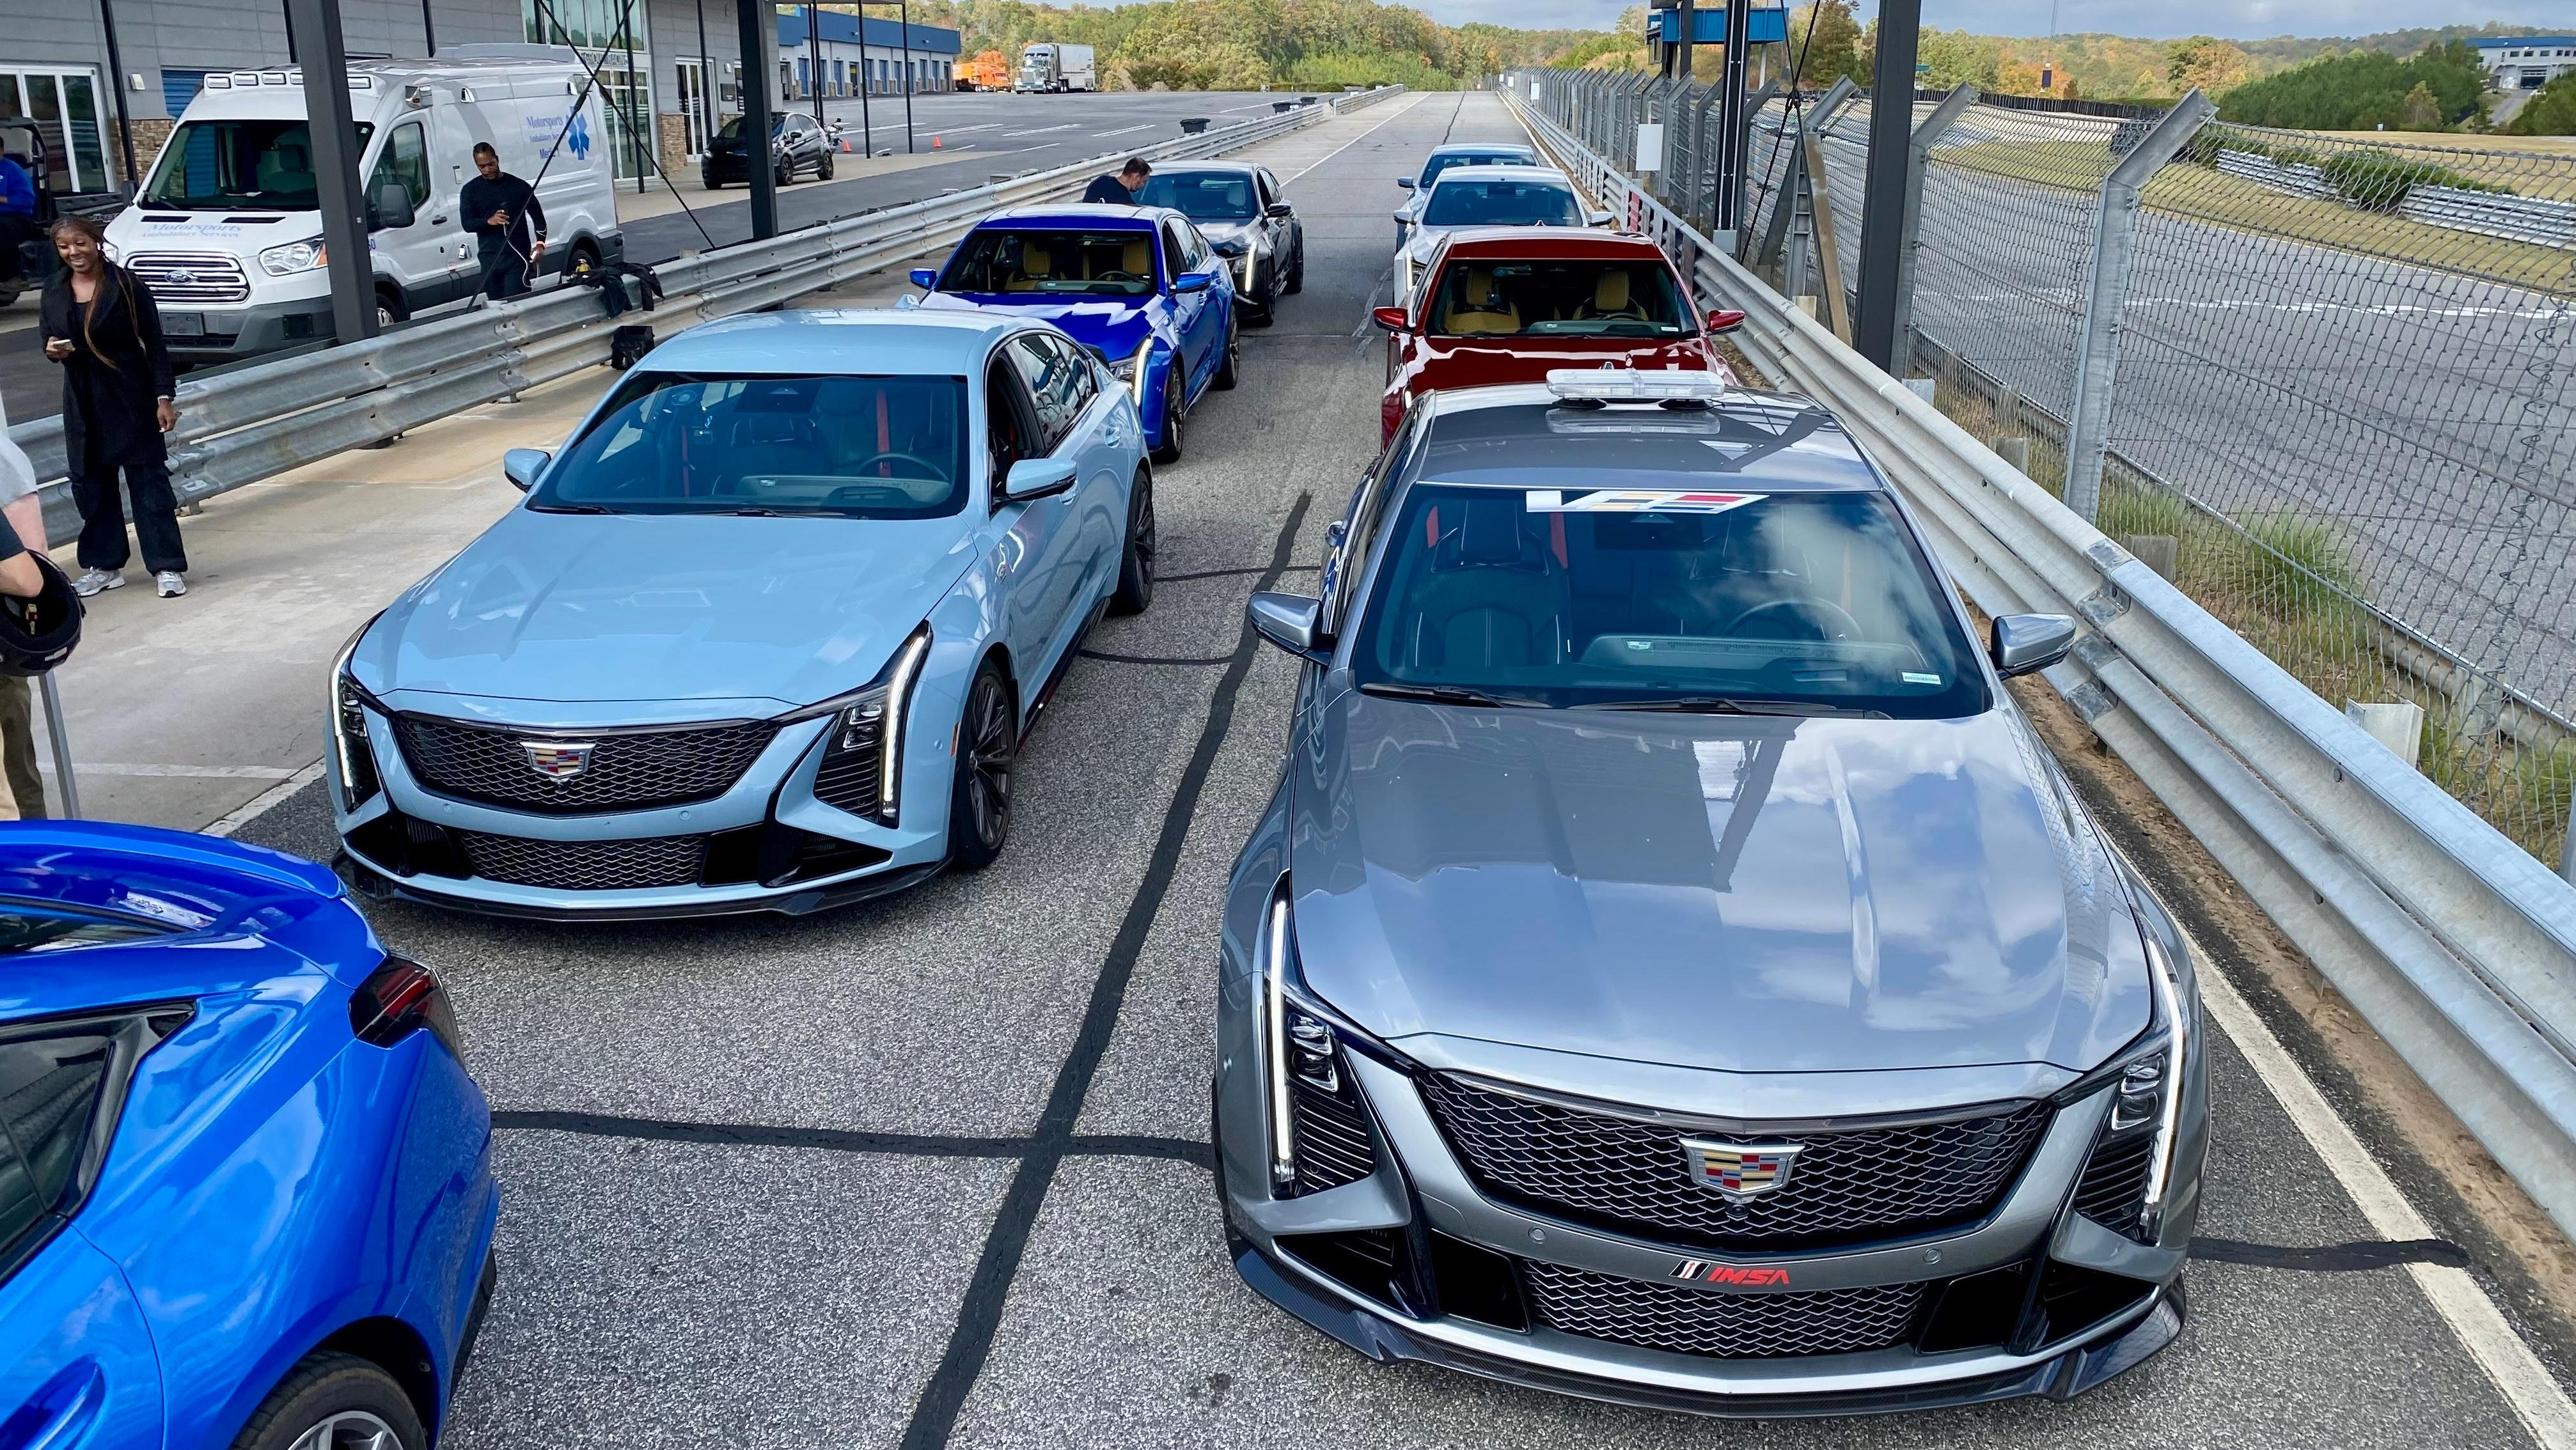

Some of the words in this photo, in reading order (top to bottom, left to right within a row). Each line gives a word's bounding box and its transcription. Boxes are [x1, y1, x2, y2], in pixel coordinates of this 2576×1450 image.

[526, 115, 563, 130] Motorsports
[148, 224, 242, 234] Motorsports
[1708, 1267, 1789, 1285] IMSA
